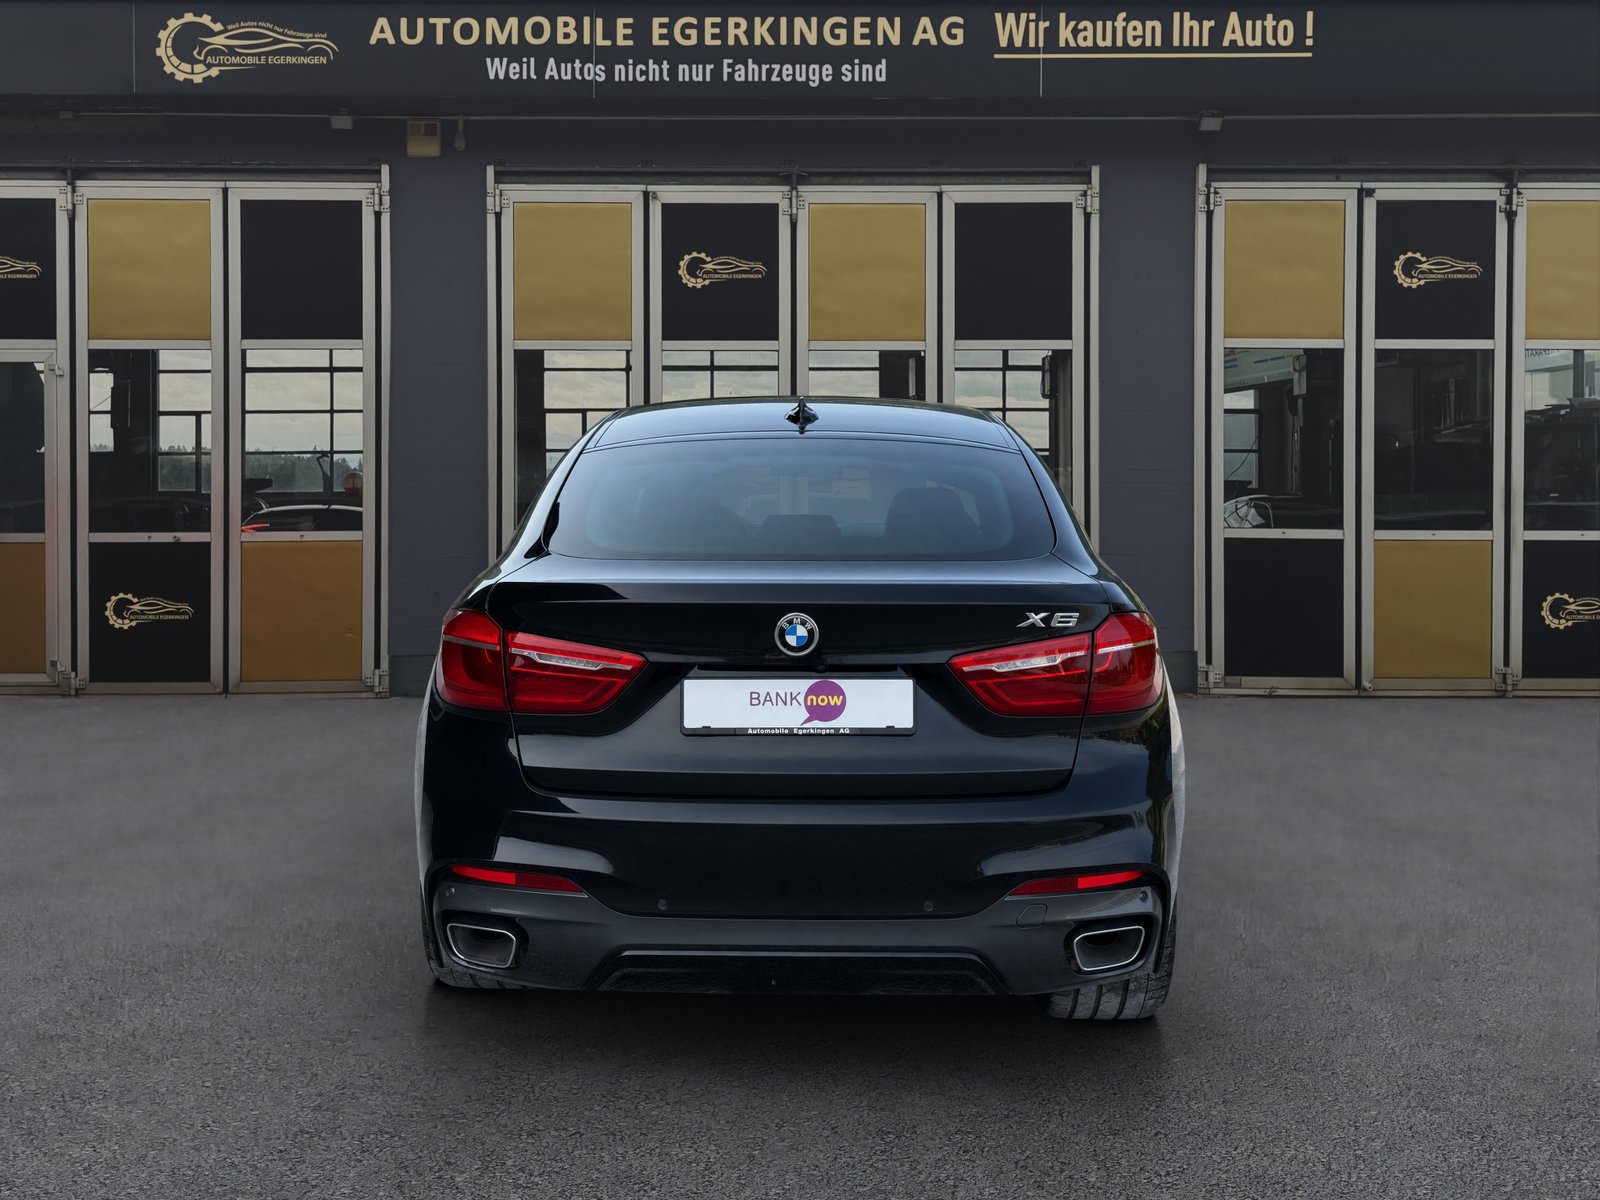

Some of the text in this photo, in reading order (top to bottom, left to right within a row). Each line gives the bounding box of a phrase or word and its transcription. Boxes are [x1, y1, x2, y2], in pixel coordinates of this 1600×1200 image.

[369, 16, 965, 46] AUTOMOBILE EGERKINGEN AG
[994, 10, 1314, 48] Wir kaufen Ihr Auto !
[206, 56, 327, 64] AUTOMOBILE EGERKINGEN
[485, 57, 887, 87] Weil Autos nicht nur Fahrzeuge sind
[781, 617, 813, 630] BMW
[1016, 612, 1080, 628] X6
[749, 691, 844, 706] BANK now
